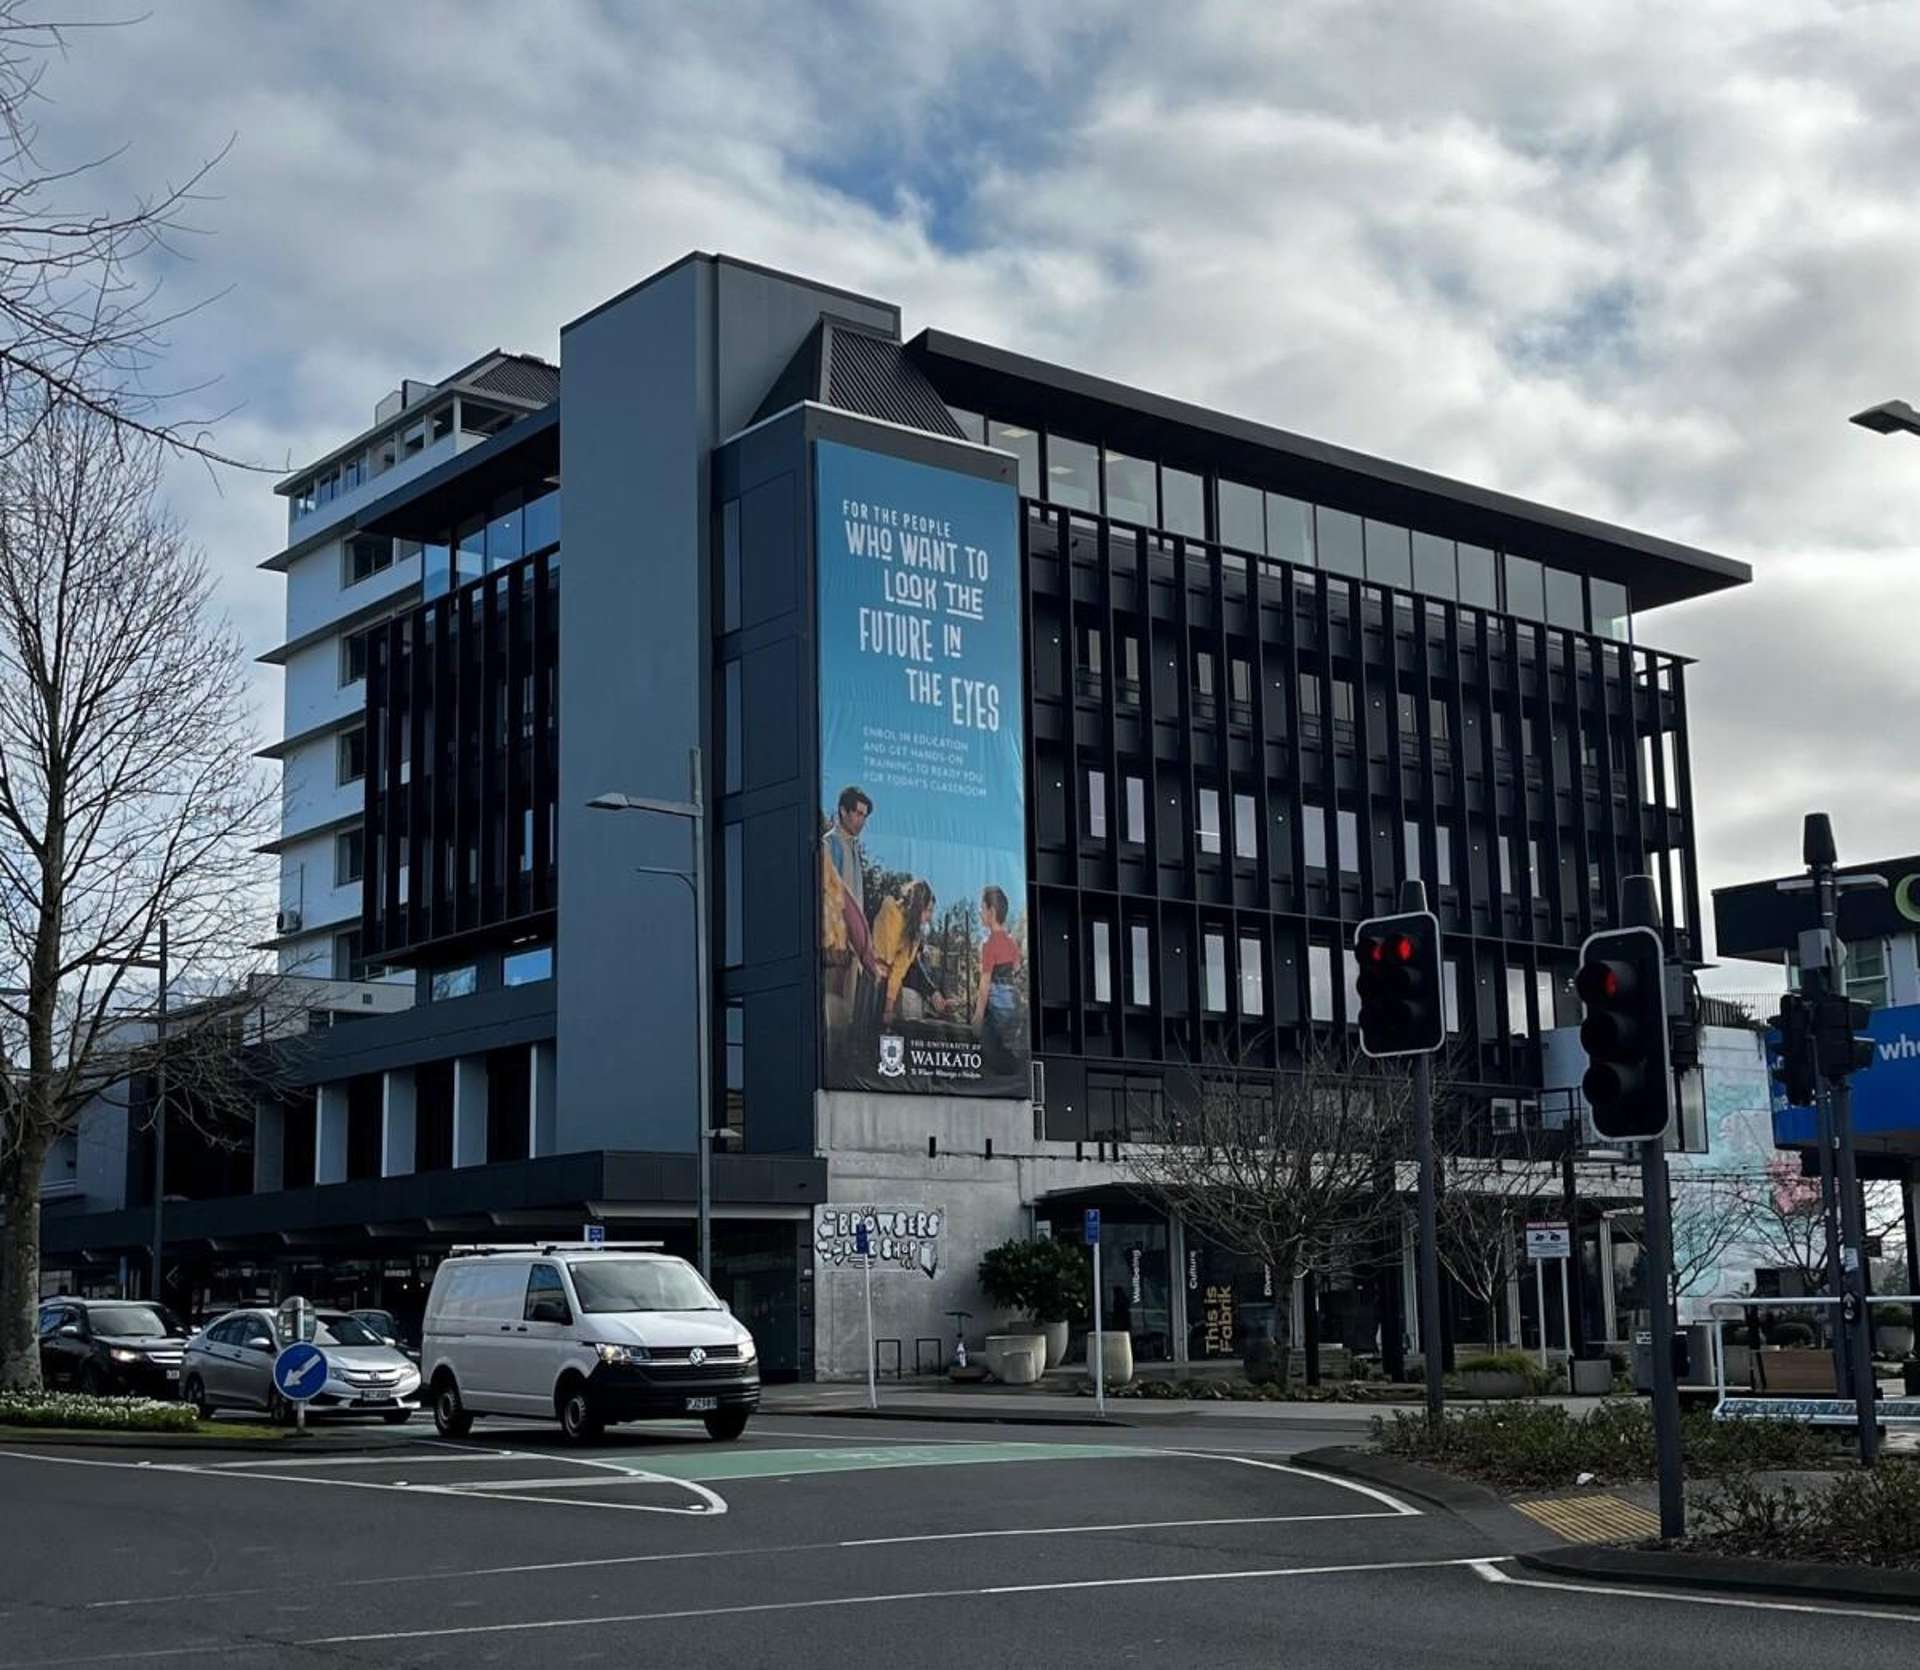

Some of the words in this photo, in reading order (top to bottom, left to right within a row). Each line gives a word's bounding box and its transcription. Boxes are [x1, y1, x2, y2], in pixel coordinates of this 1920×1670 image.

[843, 499, 868, 520] FOR
[872, 506, 898, 526] THE
[903, 512, 951, 538] PEOPLE
[845, 520, 893, 561] WHO
[899, 531, 958, 575] WANT
[964, 545, 989, 582] TO
[884, 569, 937, 610] LOOK
[944, 581, 983, 620] THE
[859, 607, 933, 662] FUTURE
[943, 623, 961, 658] IN
[905, 668, 942, 706] THE
[951, 677, 999, 732] EYES
[863, 726, 897, 740] ENROL
[863, 742, 886, 754] AND
[911, 1050, 982, 1069] WAIKATO
[880, 1238, 917, 1261] SHOP
[1189, 1250, 1198, 1290] Culture
[1263, 1262, 1273, 1297] Diver
[1204, 1285, 1217, 1304] is
[1204, 1309, 1219, 1354] This
[1217, 1284, 1234, 1353] Fabrik
